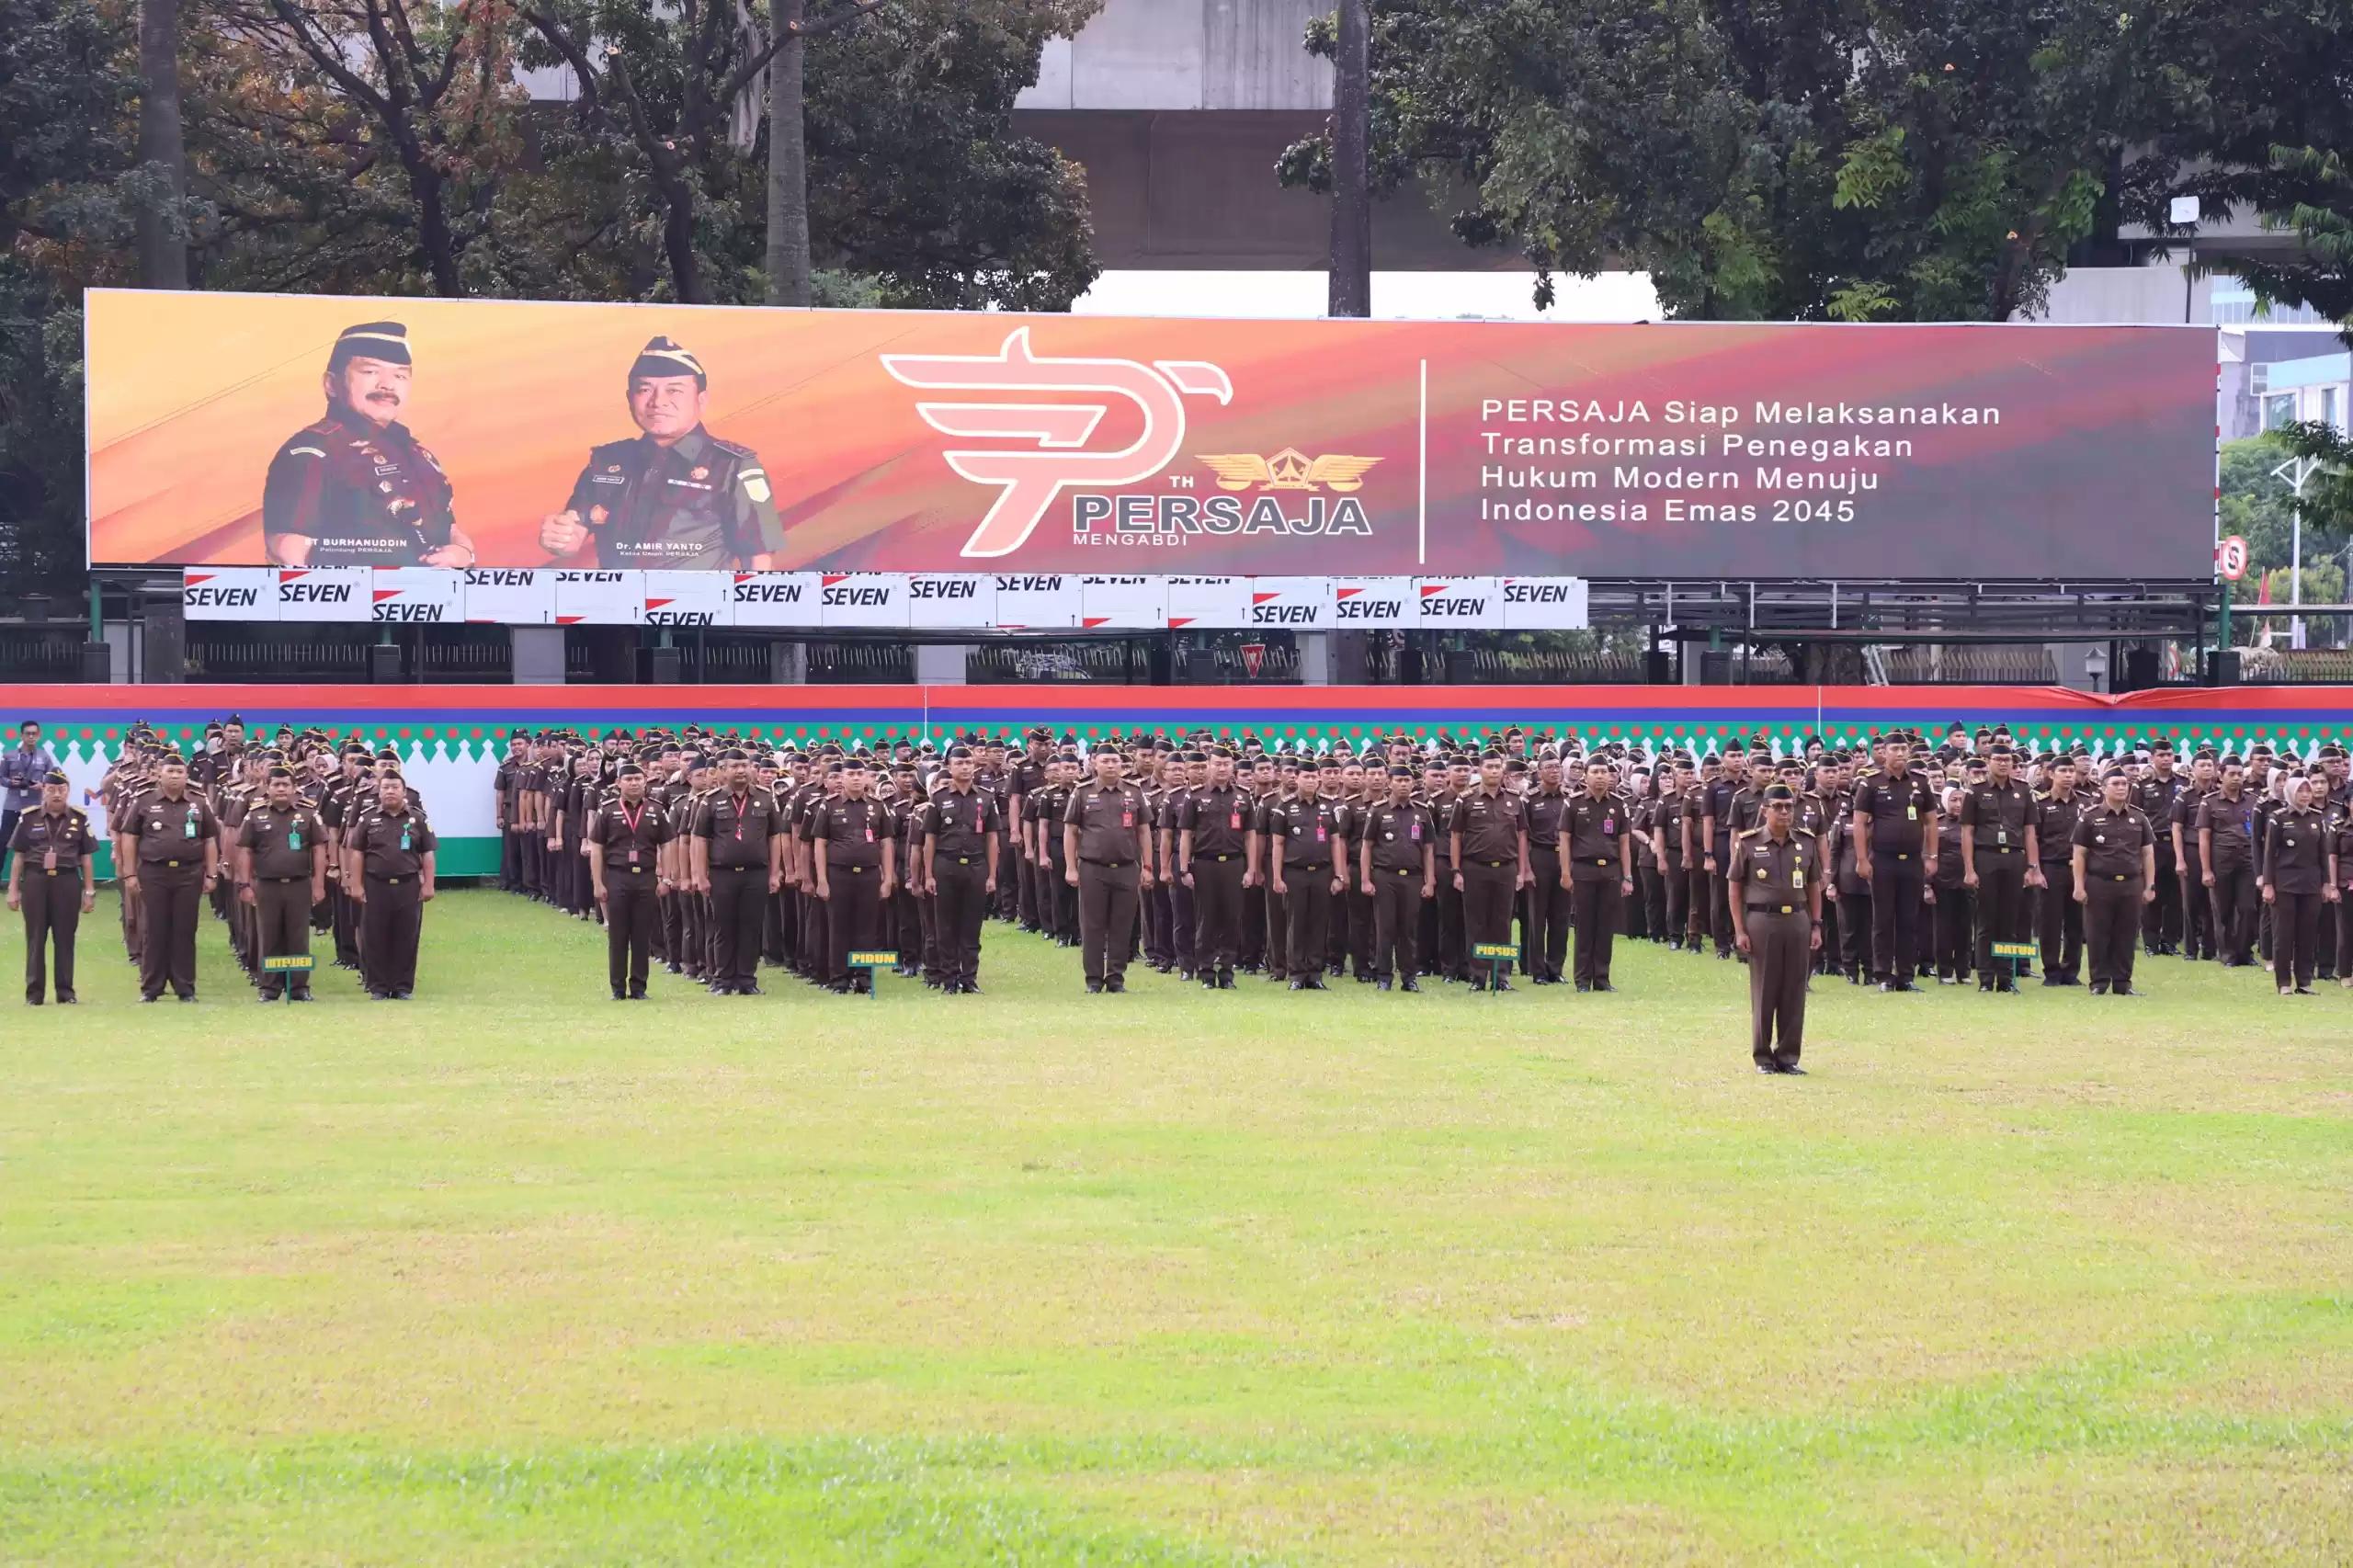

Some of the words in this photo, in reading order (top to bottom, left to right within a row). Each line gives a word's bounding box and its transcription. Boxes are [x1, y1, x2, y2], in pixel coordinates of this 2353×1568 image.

[1482, 399, 1651, 423] PERSAJA
[1664, 400, 1739, 428] Siap
[1756, 401, 1999, 426] Melaksanakan
[1481, 432, 1706, 456] Transformasi
[1723, 434, 1912, 461] Penegakan
[1168, 475, 1194, 488] TH
[1482, 465, 1597, 488] Hukum
[1614, 466, 1739, 489] Modern
[1756, 467, 1878, 494] Menuju
[1073, 494, 1373, 536] PERSAJA
[1482, 498, 1648, 522] Indonesia
[1665, 499, 1756, 522] Emas
[1772, 499, 1856, 522] 2045
[324, 539, 407, 547] BURHANUDDIN
[634, 542, 662, 551] AMIR
[1073, 533, 1187, 546] MENGABDI
[465, 570, 534, 586] SEVEN
[997, 577, 1063, 591] SEVEN
[186, 588, 257, 607] SEVEN
[280, 585, 351, 603] SEVEN
[735, 585, 802, 603] SEVEN
[823, 588, 890, 606] SEVEN
[910, 581, 977, 598] SEVEN
[1505, 585, 1568, 603] SEVEN
[373, 604, 444, 622] SEVEN
[1254, 606, 1318, 623] SEVEN
[1337, 601, 1402, 619] SEVEN
[1421, 599, 1485, 616] SEVEN
[646, 611, 713, 625] SEVEN
[851, 953, 896, 964] PIDUM
[1475, 945, 1518, 957] PIDSUS
